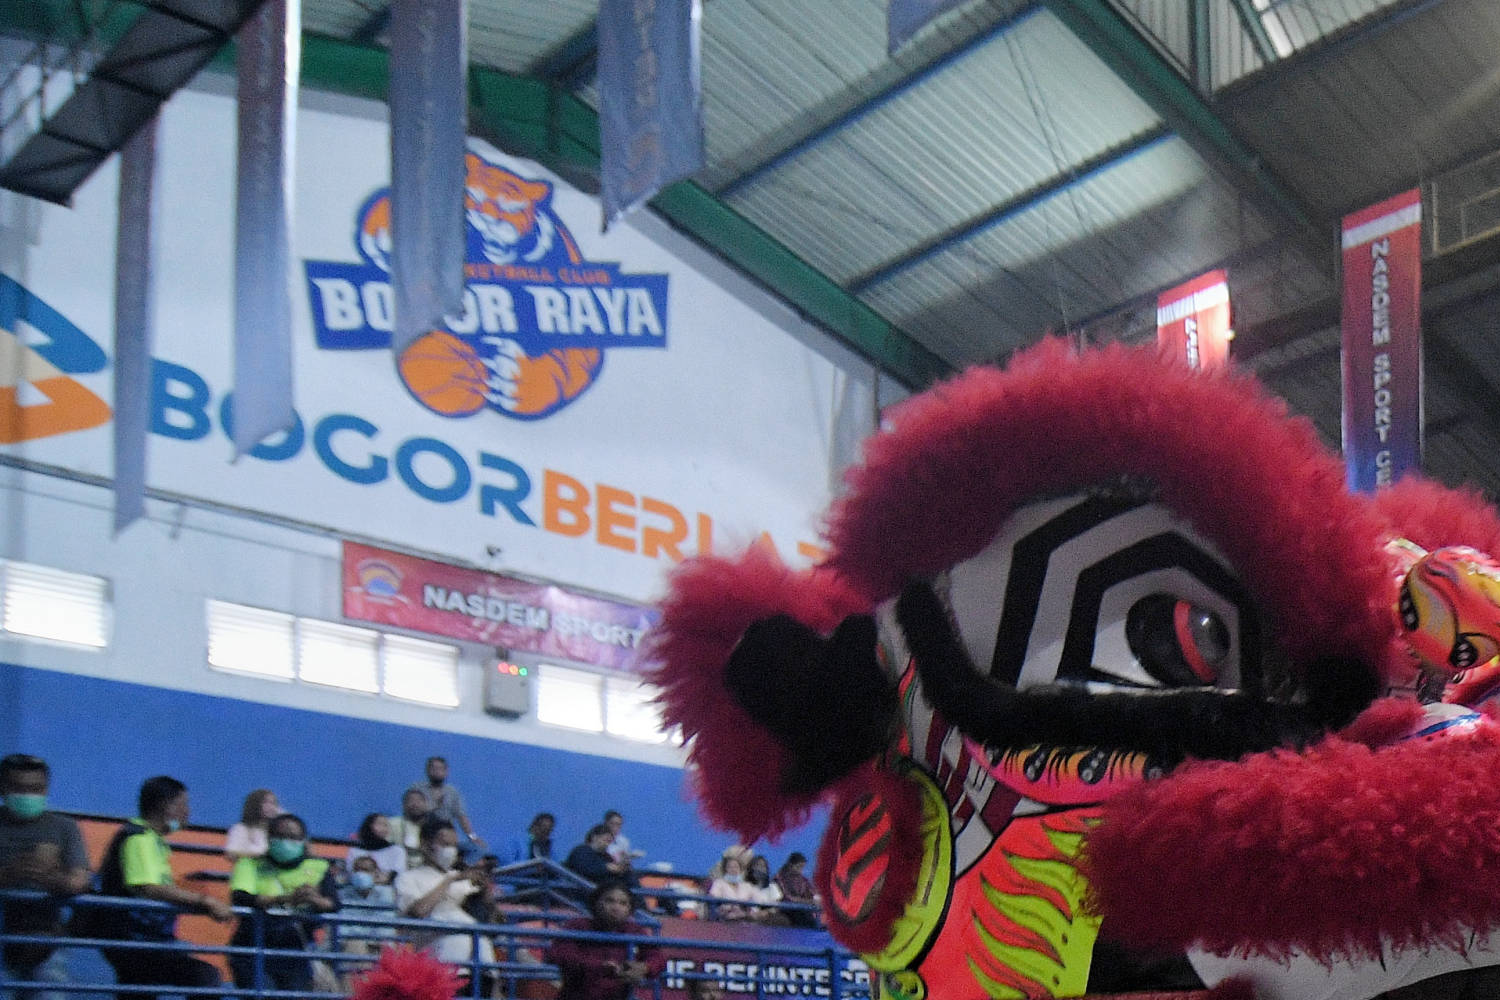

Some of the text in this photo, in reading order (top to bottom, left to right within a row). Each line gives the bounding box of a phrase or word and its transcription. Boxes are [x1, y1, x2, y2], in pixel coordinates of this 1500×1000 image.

[311, 277, 664, 336] BOOR RAYA
[1371, 238, 1391, 346] NASDEM
[1373, 353, 1391, 442] SPORT
[423, 583, 644, 648] NASDEM SPORT
